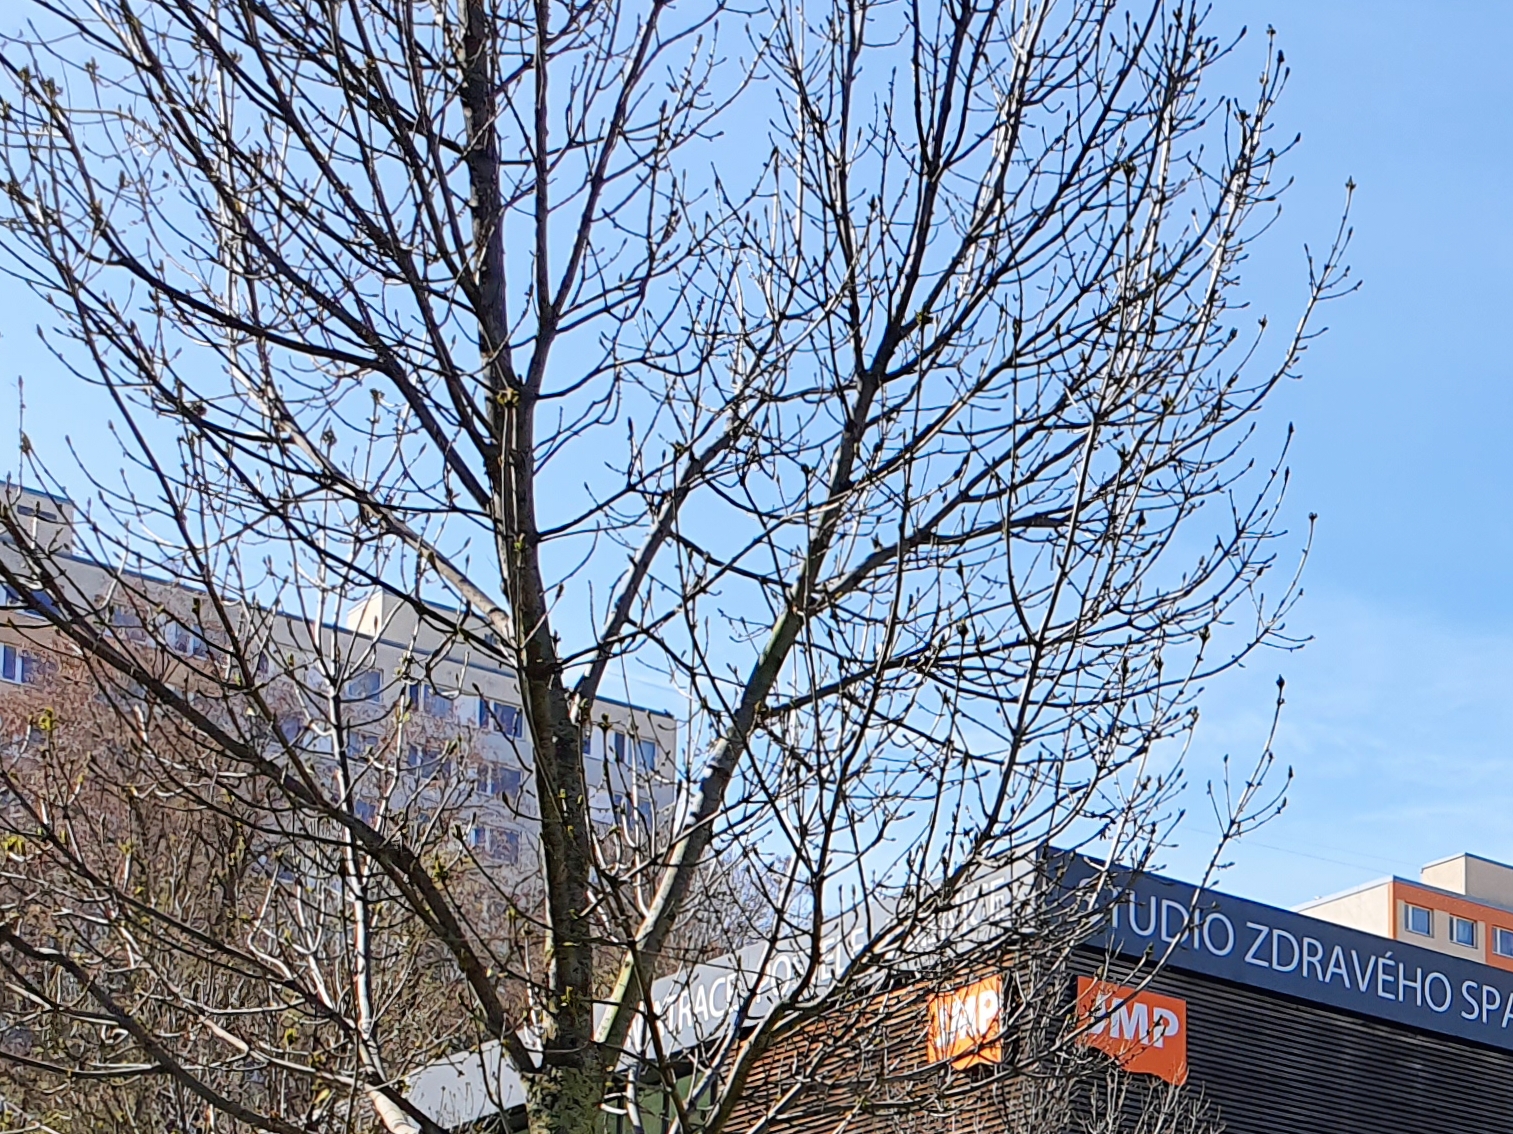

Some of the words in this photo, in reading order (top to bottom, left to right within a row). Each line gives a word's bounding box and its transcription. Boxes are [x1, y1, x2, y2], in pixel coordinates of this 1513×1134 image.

[1078, 878, 1236, 956] TUDIO
[1244, 921, 1452, 1013] ZDRAVÉHO
[1088, 989, 1179, 1049] JMP
